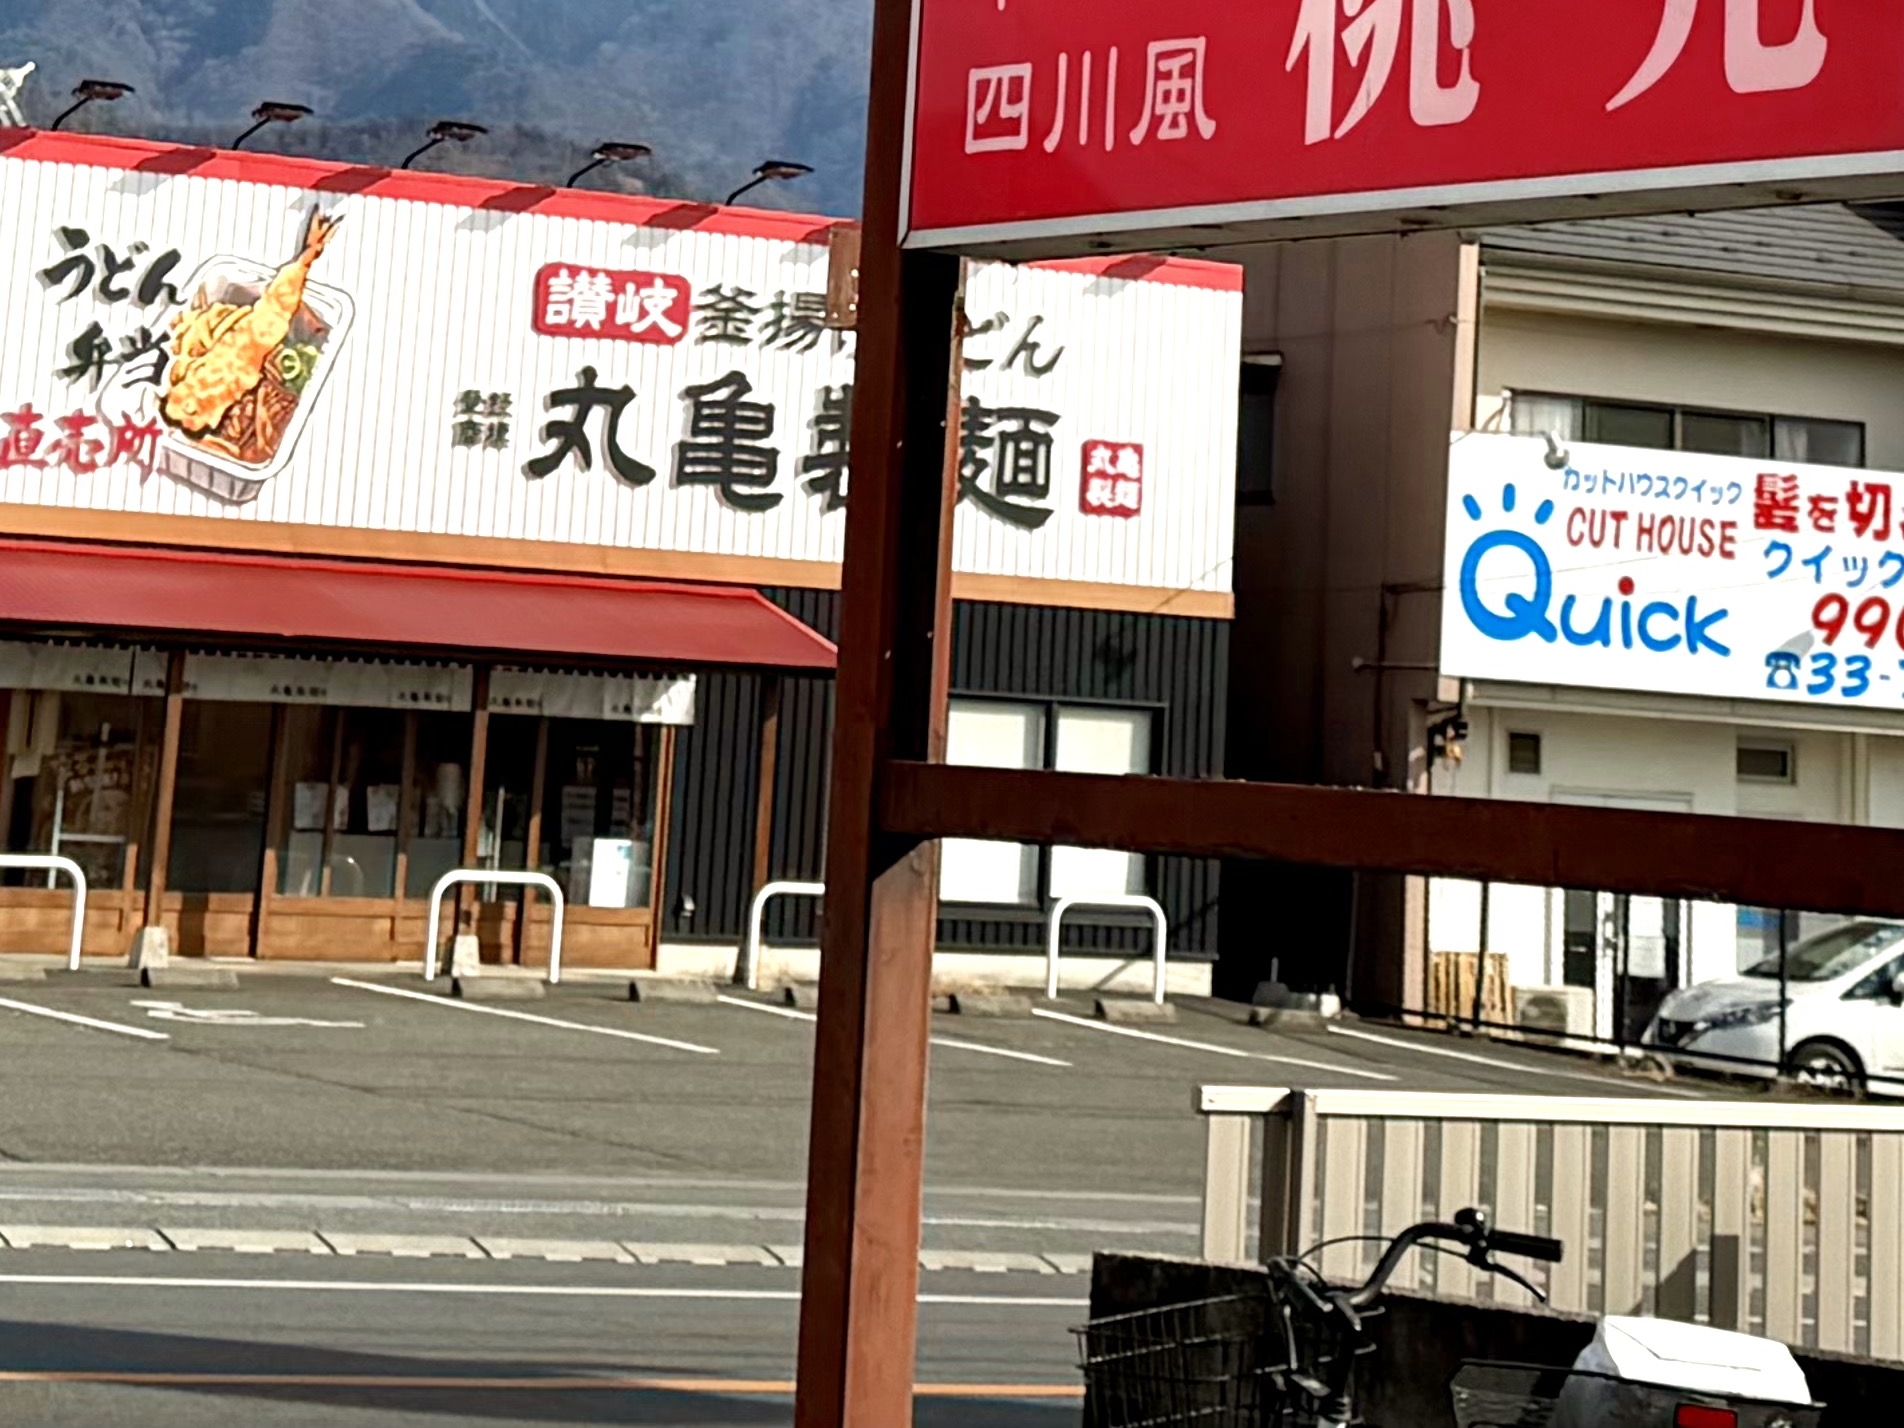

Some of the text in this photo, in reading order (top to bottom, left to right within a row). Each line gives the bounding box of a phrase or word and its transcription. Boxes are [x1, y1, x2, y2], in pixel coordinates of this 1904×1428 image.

[964, 34, 1216, 156] 四川風
[37, 225, 186, 307] うどん
[544, 267, 678, 336] 讃岐
[53, 319, 172, 395] 弁当
[1563, 468, 1743, 506] カットハウスクイック
[1566, 506, 1736, 560] CUT HOUSE
[1459, 528, 1731, 658] Quick
